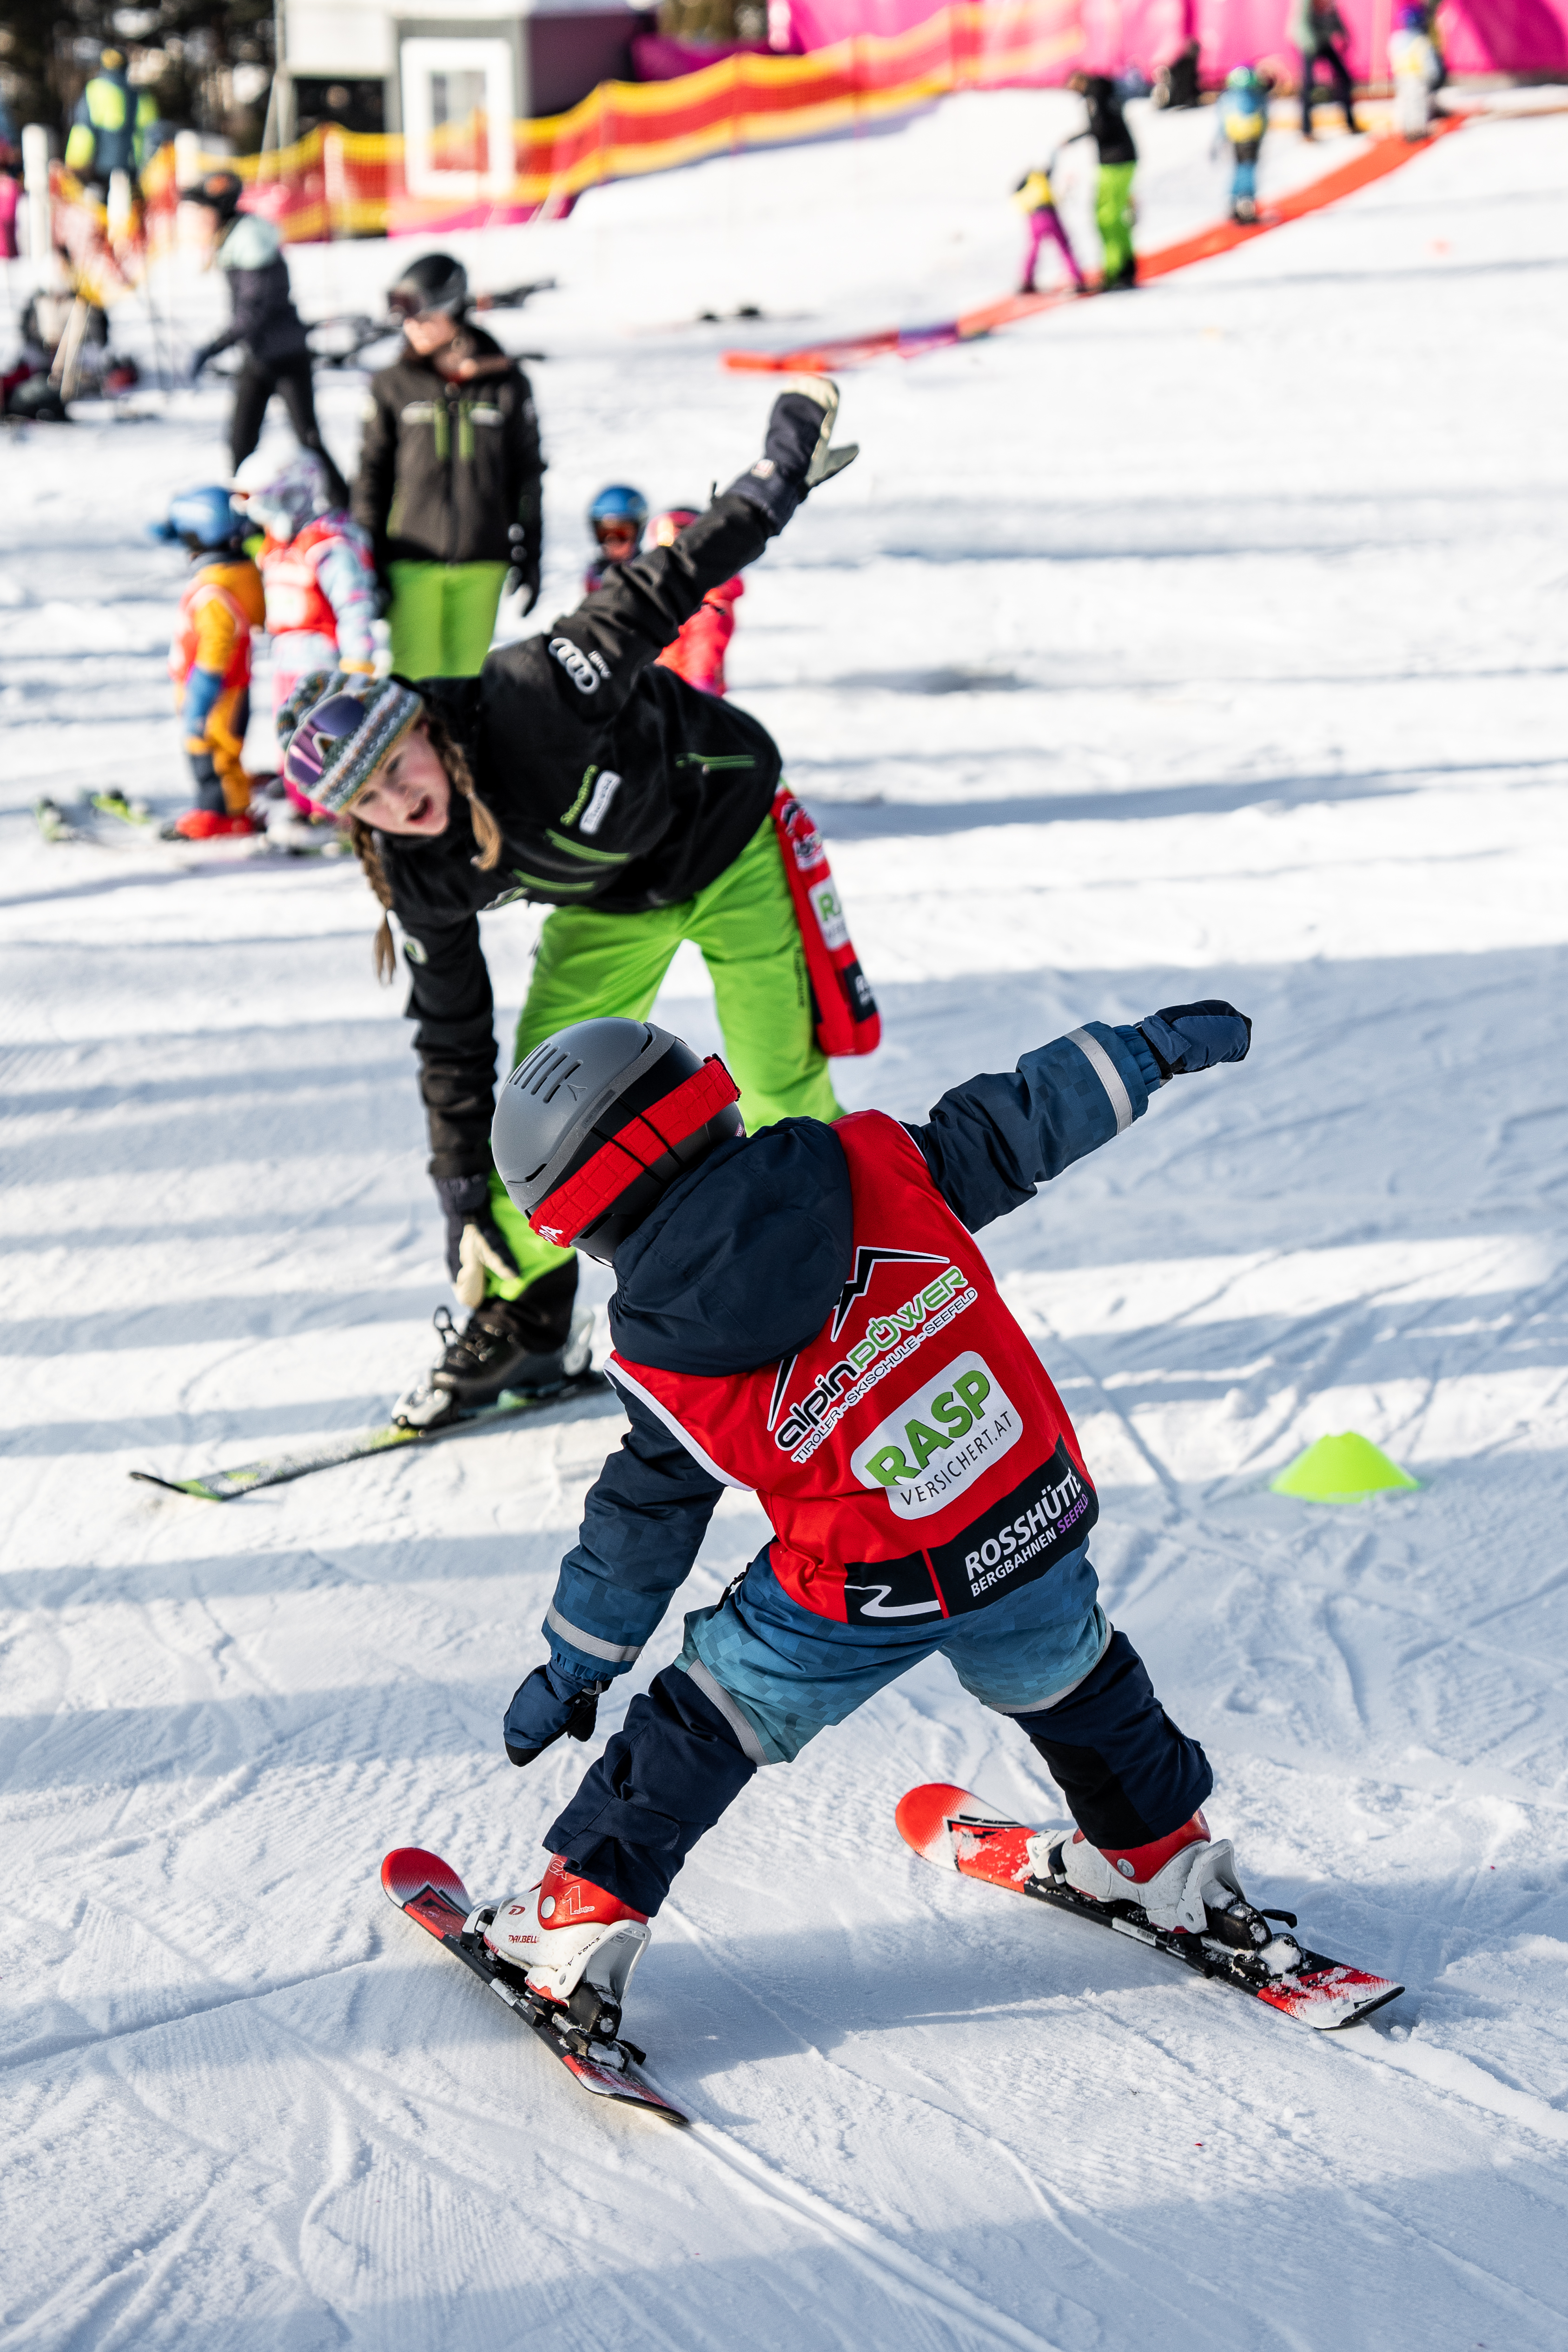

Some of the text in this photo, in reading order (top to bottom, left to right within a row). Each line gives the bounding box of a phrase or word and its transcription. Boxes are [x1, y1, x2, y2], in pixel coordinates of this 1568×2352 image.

[794, 1410, 841, 1461] TIROLER
[847, 1338, 918, 1404] SKISCHULE
[925, 1290, 976, 1334] SEEFELD
[865, 1370, 991, 1486] RASP
[900, 1411, 1012, 1505] VERSICHERT.AT
[970, 1493, 1088, 1597] BERGBAHNEN SEEFELD
[508, 1935, 540, 1943] DALBELL
